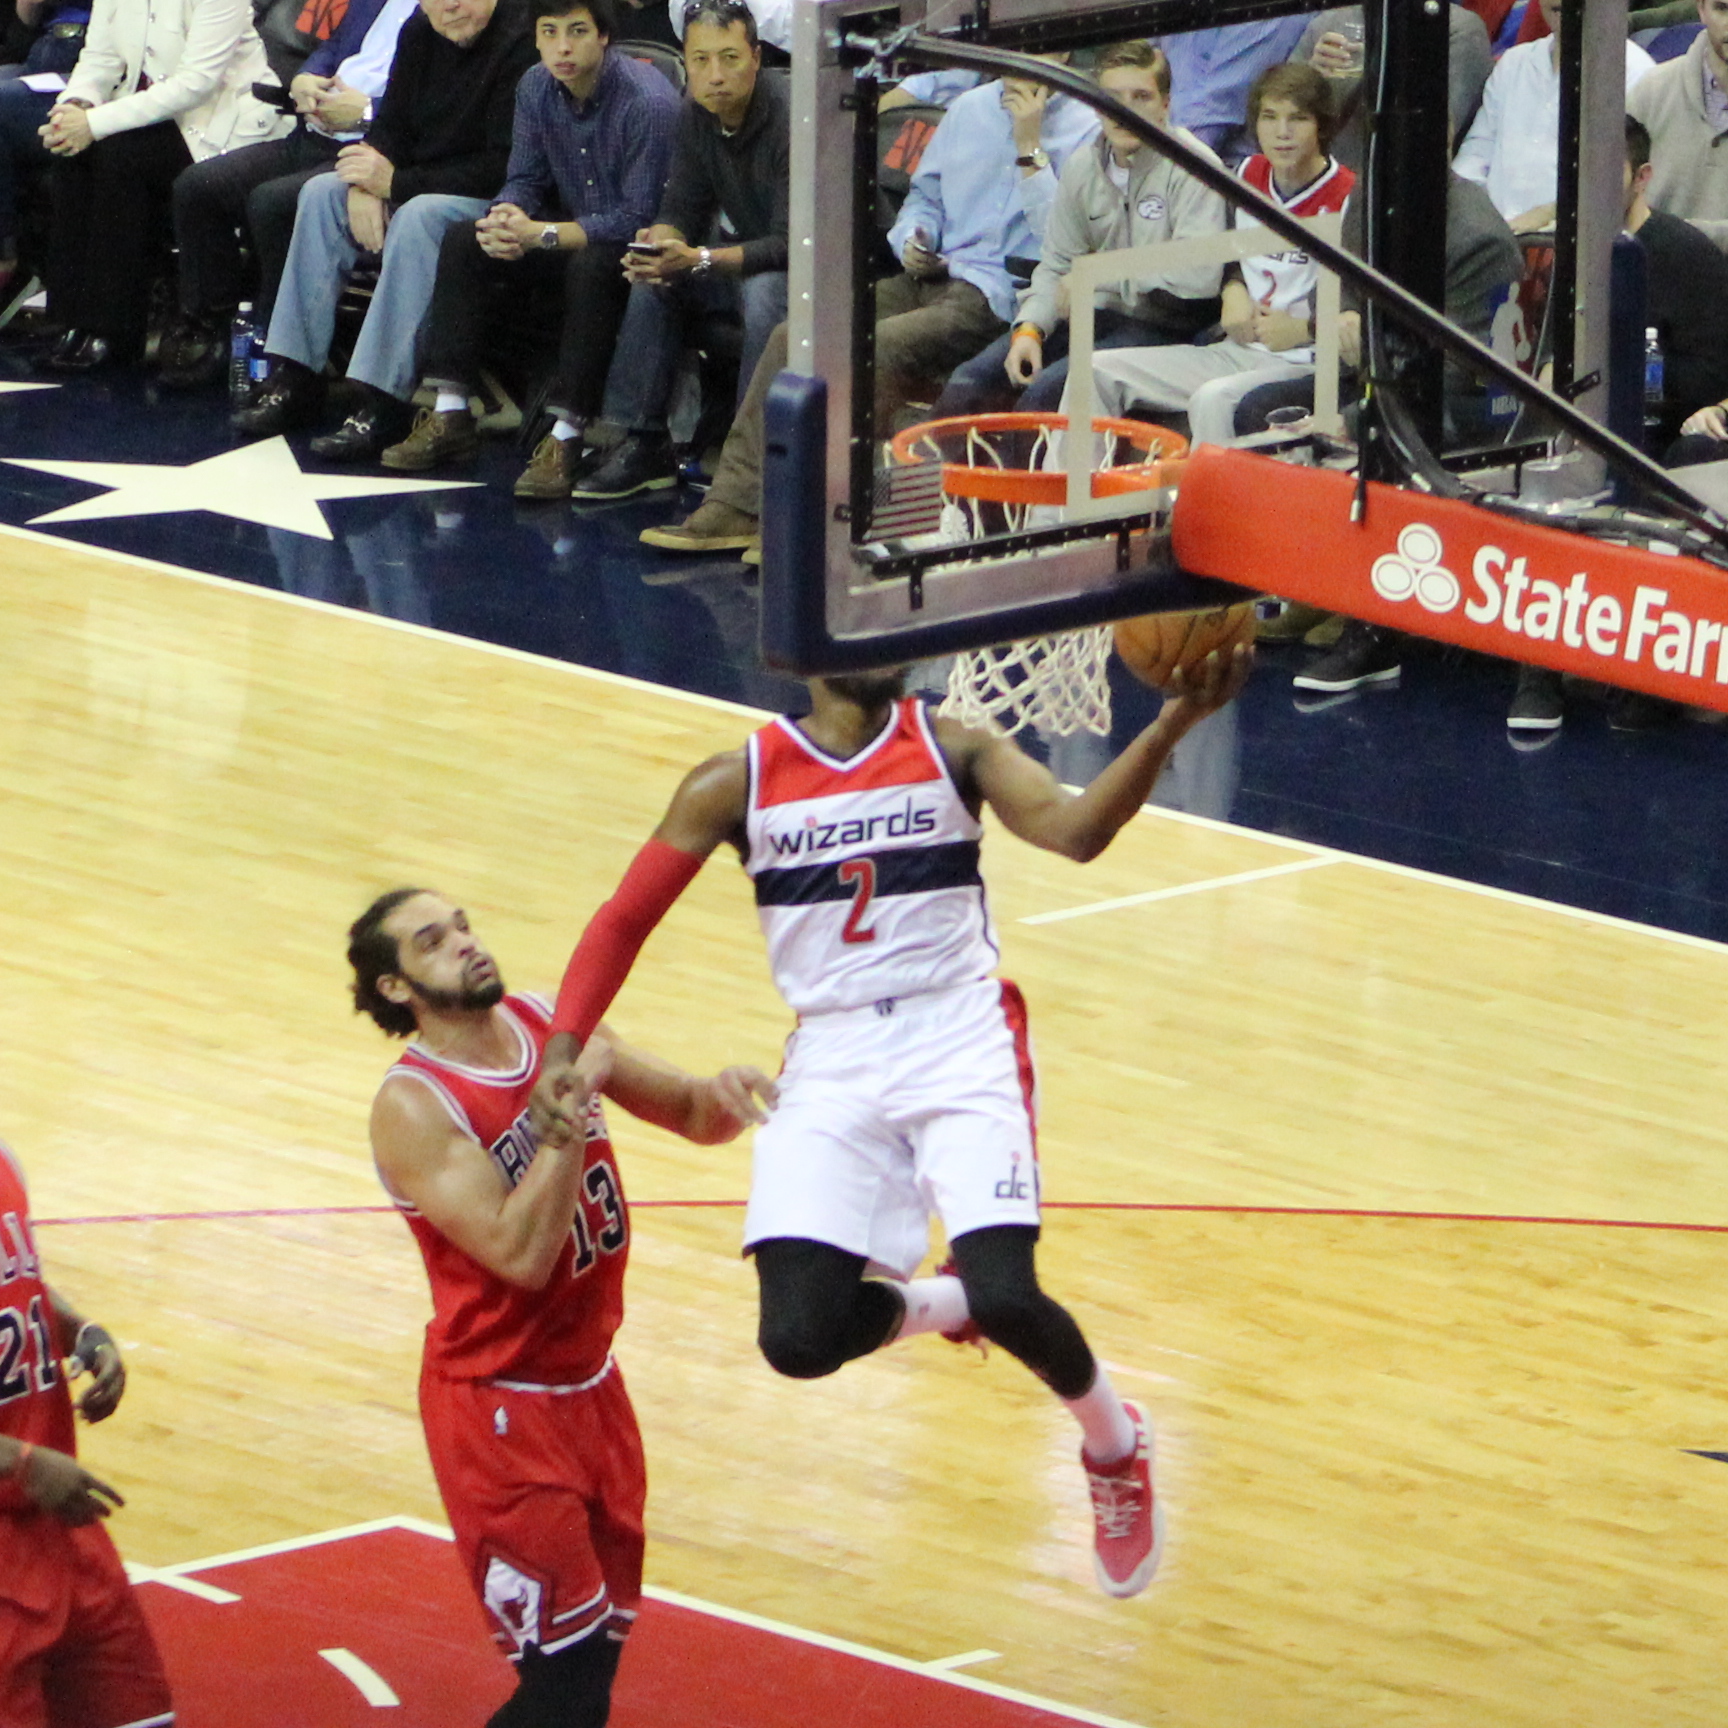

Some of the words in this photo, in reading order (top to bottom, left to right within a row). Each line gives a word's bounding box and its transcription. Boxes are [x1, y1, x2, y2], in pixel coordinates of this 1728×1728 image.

[768, 795, 936, 859] wizards
[837, 856, 877, 946] 2
[572, 1158, 625, 1279] 13
